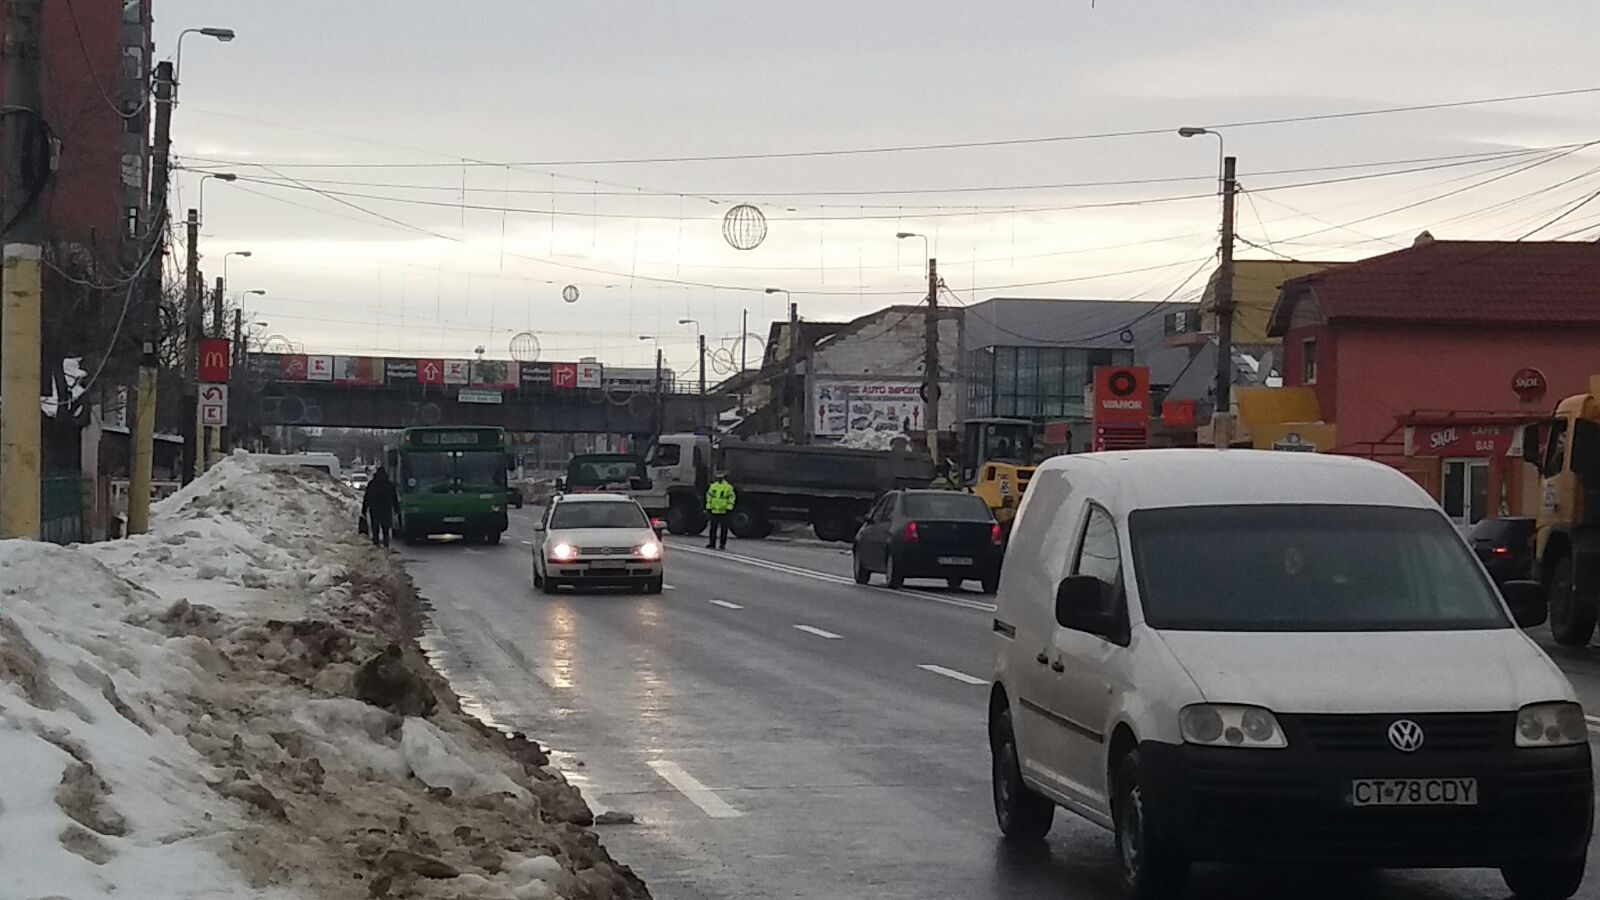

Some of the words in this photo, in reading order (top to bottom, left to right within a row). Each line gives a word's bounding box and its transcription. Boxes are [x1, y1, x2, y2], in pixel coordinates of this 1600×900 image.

[863, 385, 886, 394] AUTO
[1102, 399, 1143, 409] VIANOR
[1475, 440, 1494, 451] BAR
